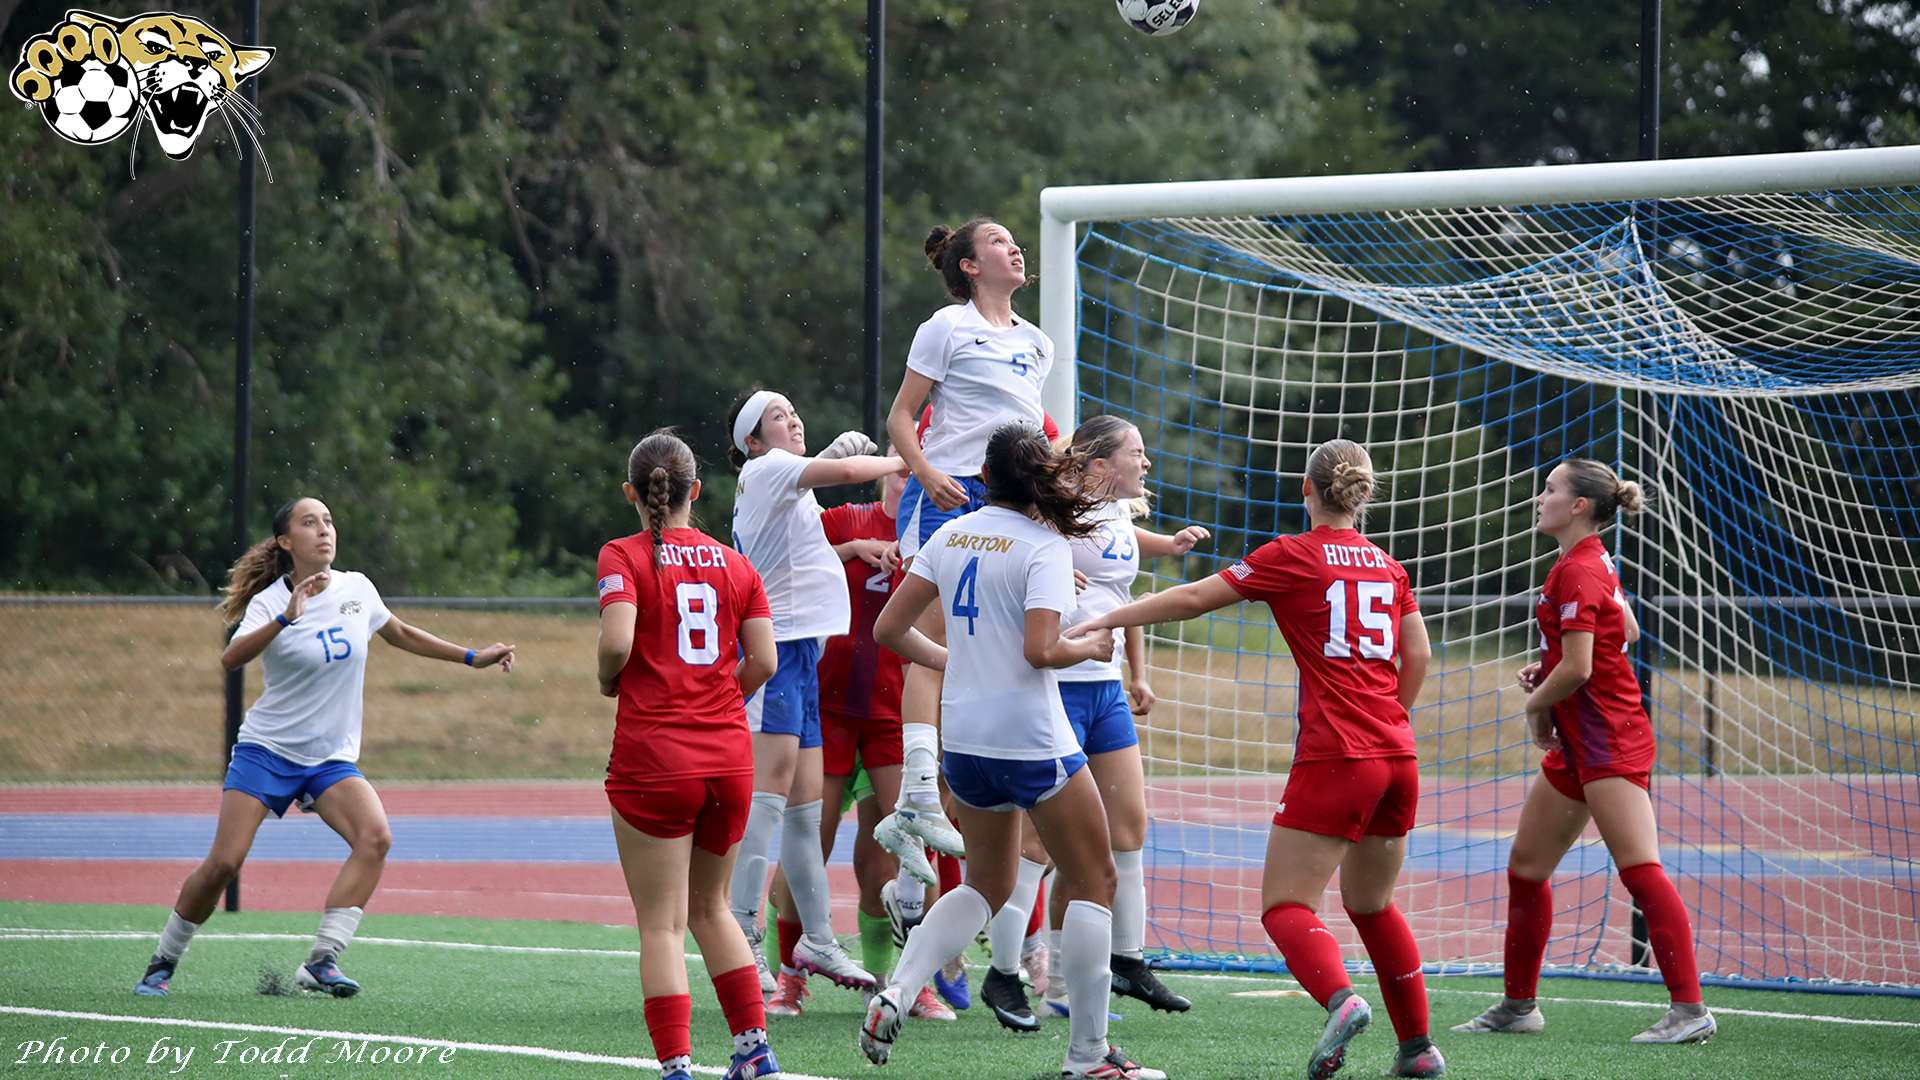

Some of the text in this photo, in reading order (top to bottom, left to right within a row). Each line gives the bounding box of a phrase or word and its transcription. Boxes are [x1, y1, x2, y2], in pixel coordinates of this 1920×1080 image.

[1012, 352, 1028, 377] 5
[945, 532, 1014, 555] BARTON
[1100, 525, 1134, 561] 23
[1322, 543, 1388, 569] HUTCH
[952, 556, 979, 636] 4
[675, 582, 720, 666] 8
[1323, 579, 1395, 661] 15
[316, 626, 352, 664] 15
